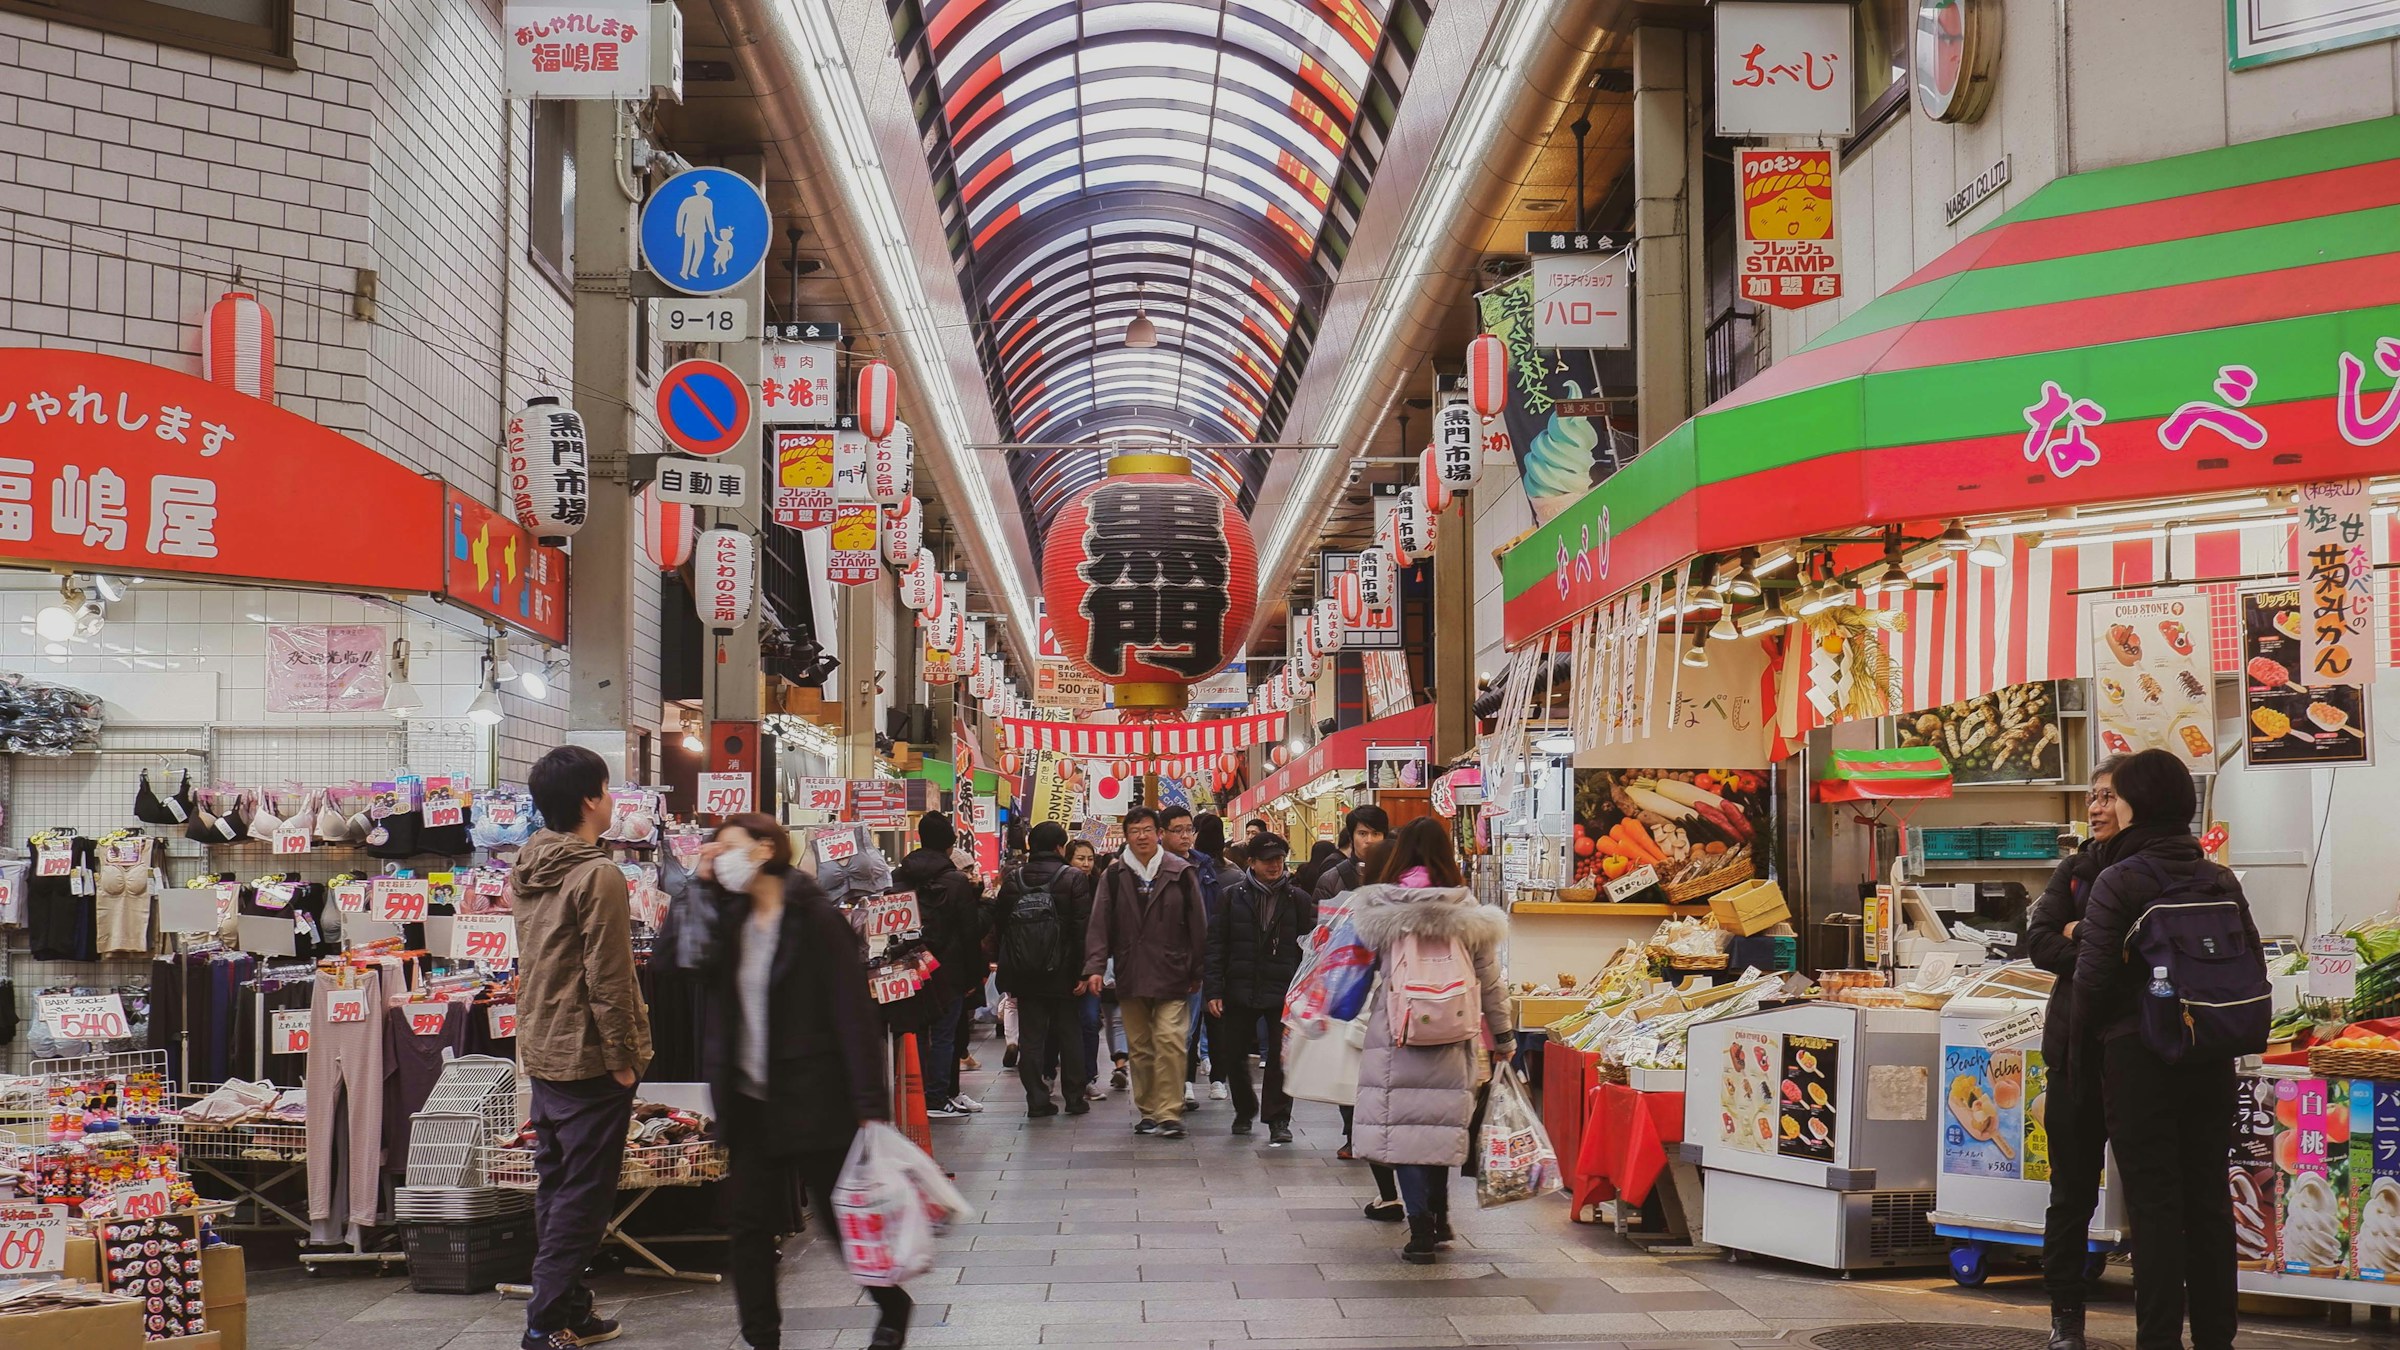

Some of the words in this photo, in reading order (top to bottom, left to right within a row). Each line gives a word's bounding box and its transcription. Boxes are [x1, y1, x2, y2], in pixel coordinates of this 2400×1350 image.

[514, 13, 638, 46] おしゃれします
[531, 42, 619, 73] 福嶋屋
[1745, 155, 1802, 175] クロモン
[1945, 182, 1974, 222] NABEJI
[1752, 241, 1824, 256] フレッシュ
[1746, 255, 1835, 273] STAMP
[1549, 272, 1613, 288] バラエティショップ
[1748, 276, 1836, 297] 加盟店
[669, 310, 734, 332] 9-18
[1544, 301, 1618, 325] ハロー
[815, 378, 829, 406] 黒門
[1563, 402, 1606, 413] 送水口
[2023, 337, 2400, 478] なべじ
[1444, 409, 1472, 482] 黒門市場
[507, 418, 540, 529] なにわの台所
[547, 412, 587, 526] 黒門市場
[876, 434, 894, 496] にわの台所
[662, 468, 742, 498] 自動車
[783, 488, 827, 497] フレッシュ
[779, 497, 834, 508] STAMP
[778, 510, 834, 522] 加盟店
[1398, 491, 1417, 552] 黒門市場
[831, 558, 876, 568] STAMP
[835, 550, 870, 558] フレッシュ
[1556, 505, 1611, 601] なべじ
[714, 536, 737, 621] なにわの台所
[831, 569, 877, 580] 加盟店
[1361, 552, 1379, 604] 黒門市場
[2348, 544, 2374, 628] なべじの
[2116, 604, 2138, 617] COLD
[2139, 603, 2169, 615] STONE
[2306, 543, 2360, 678] 菊みかん
[1327, 602, 1338, 649] ほんまもん
[728, 759, 740, 770] 消
[707, 787, 746, 813] 599
[810, 789, 842, 808] 399
[282, 834, 307, 852] 199
[827, 841, 854, 859] 399
[478, 882, 502, 895] 799
[339, 893, 362, 912] 799
[384, 892, 425, 919] 599
[876, 907, 912, 934] 199
[466, 931, 507, 957] 599
[2317, 957, 2352, 975] 500
[881, 977, 909, 1002] 199
[45, 998, 69, 1006] BABY
[333, 1001, 361, 1022] 599
[61, 1012, 123, 1038] 540
[413, 1013, 446, 1035] 599
[1983, 1026, 2006, 1039] Please
[2007, 1022, 2017, 1030] do
[2018, 1017, 2031, 1026] not
[1987, 1037, 2005, 1047] open
[2005, 1032, 2018, 1040] the
[2019, 1025, 2036, 1035] door
[1946, 1049, 1987, 1073] Peach
[1978, 1058, 2022, 1085] Melba
[2238, 1079, 2253, 1134] バニラ&
[2300, 1091, 2325, 1155] 白桃
[1988, 1161, 2013, 1173] ¥580
[115, 1179, 151, 1189] MAGNET
[123, 1191, 166, 1219] 430
